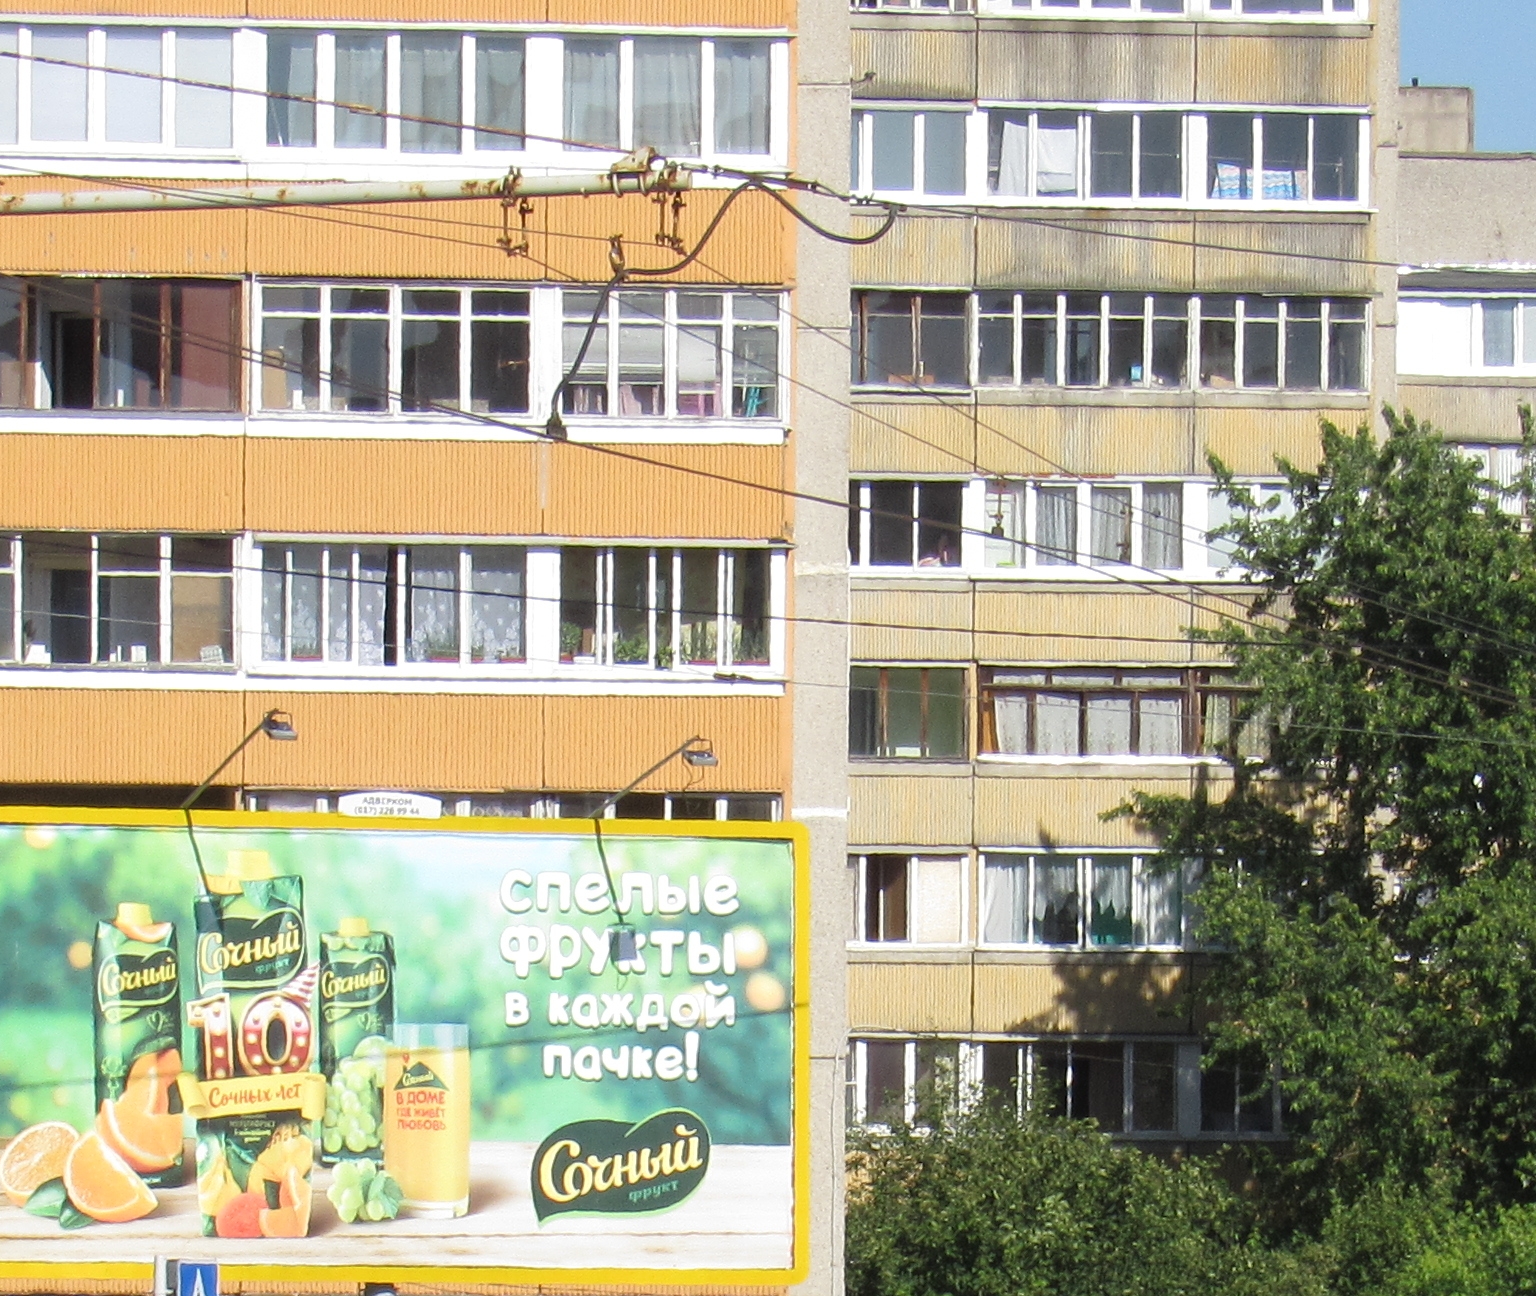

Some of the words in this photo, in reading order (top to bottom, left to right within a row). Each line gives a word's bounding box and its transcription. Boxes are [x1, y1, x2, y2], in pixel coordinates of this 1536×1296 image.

[201, 920, 301, 974] Сочный
[102, 957, 176, 997] Сочный
[321, 963, 386, 999] Сочный
[548, 980, 736, 1033] каждой
[187, 990, 314, 1080] 10
[543, 1031, 700, 1082] пачке!
[208, 1085, 272, 1108] Сочных
[396, 1091, 404, 1106] В
[407, 1090, 446, 1106] ДОМЕ
[397, 1118, 447, 1131] ЛЮБОВЬ
[539, 1123, 704, 1203] Сочный
[628, 1179, 680, 1203] фрукт
